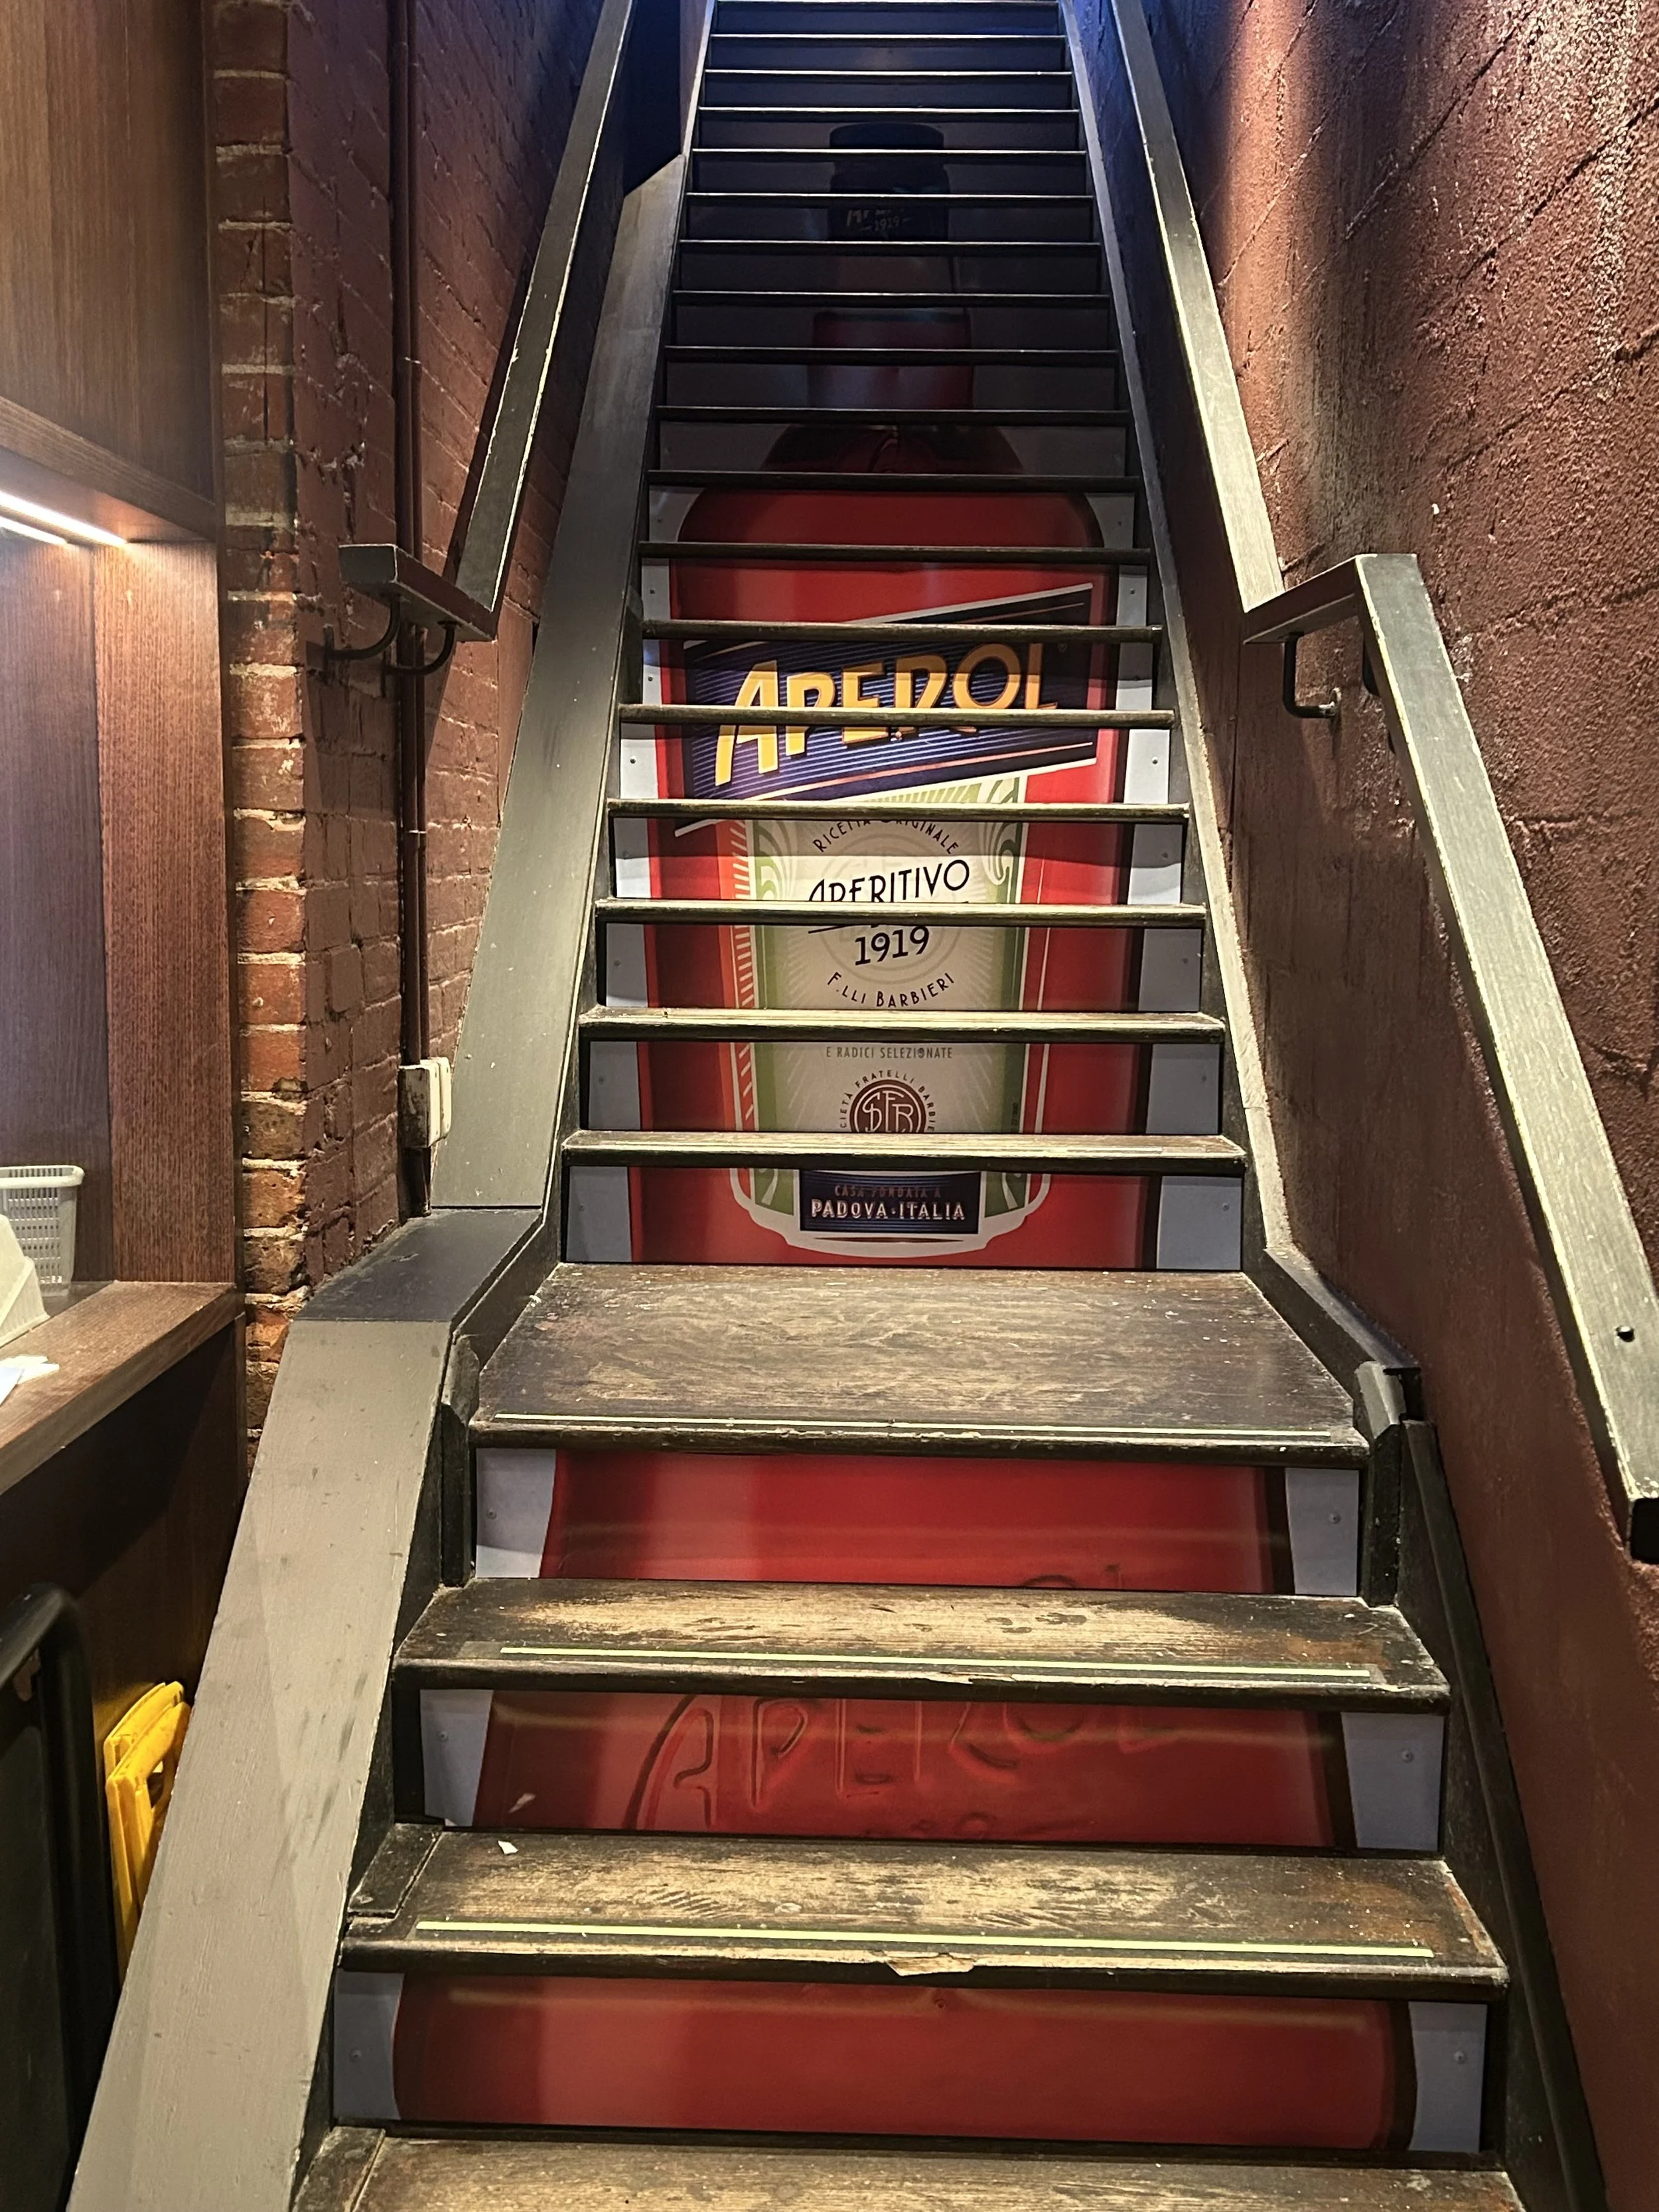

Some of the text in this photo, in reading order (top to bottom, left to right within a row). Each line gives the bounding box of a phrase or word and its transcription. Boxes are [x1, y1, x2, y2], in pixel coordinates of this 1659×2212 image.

[855, 926, 930, 966] 1919
[876, 973, 954, 1007] BARBIERI
[826, 1047, 953, 1059] E RADICI SELEZIONATE
[855, 1070, 915, 1088] FRATELLI
[918, 1086, 936, 1132] BARBIE
